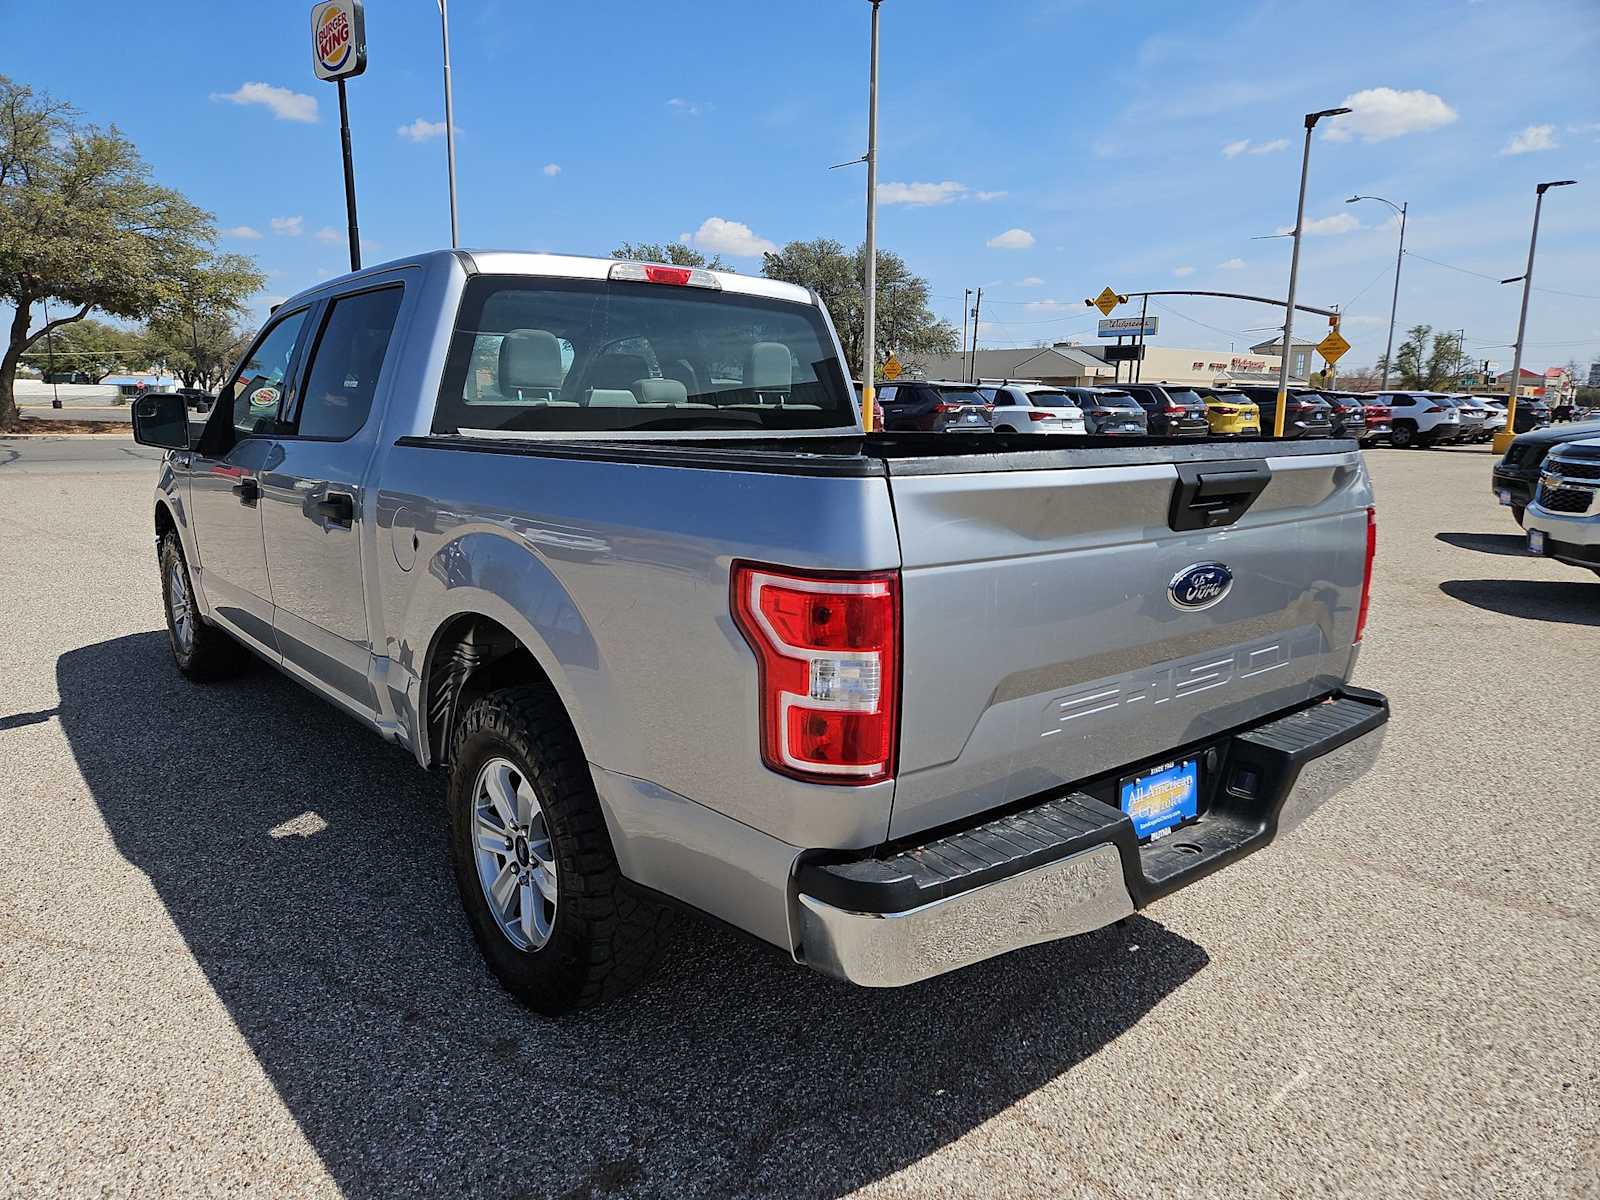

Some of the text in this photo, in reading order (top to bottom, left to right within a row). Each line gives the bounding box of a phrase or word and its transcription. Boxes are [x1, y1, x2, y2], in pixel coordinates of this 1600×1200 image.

[319, 12, 347, 44] BURGER
[320, 24, 349, 61] KING
[1186, 571, 1223, 601] Ford
[1040, 639, 1291, 737] F-150
